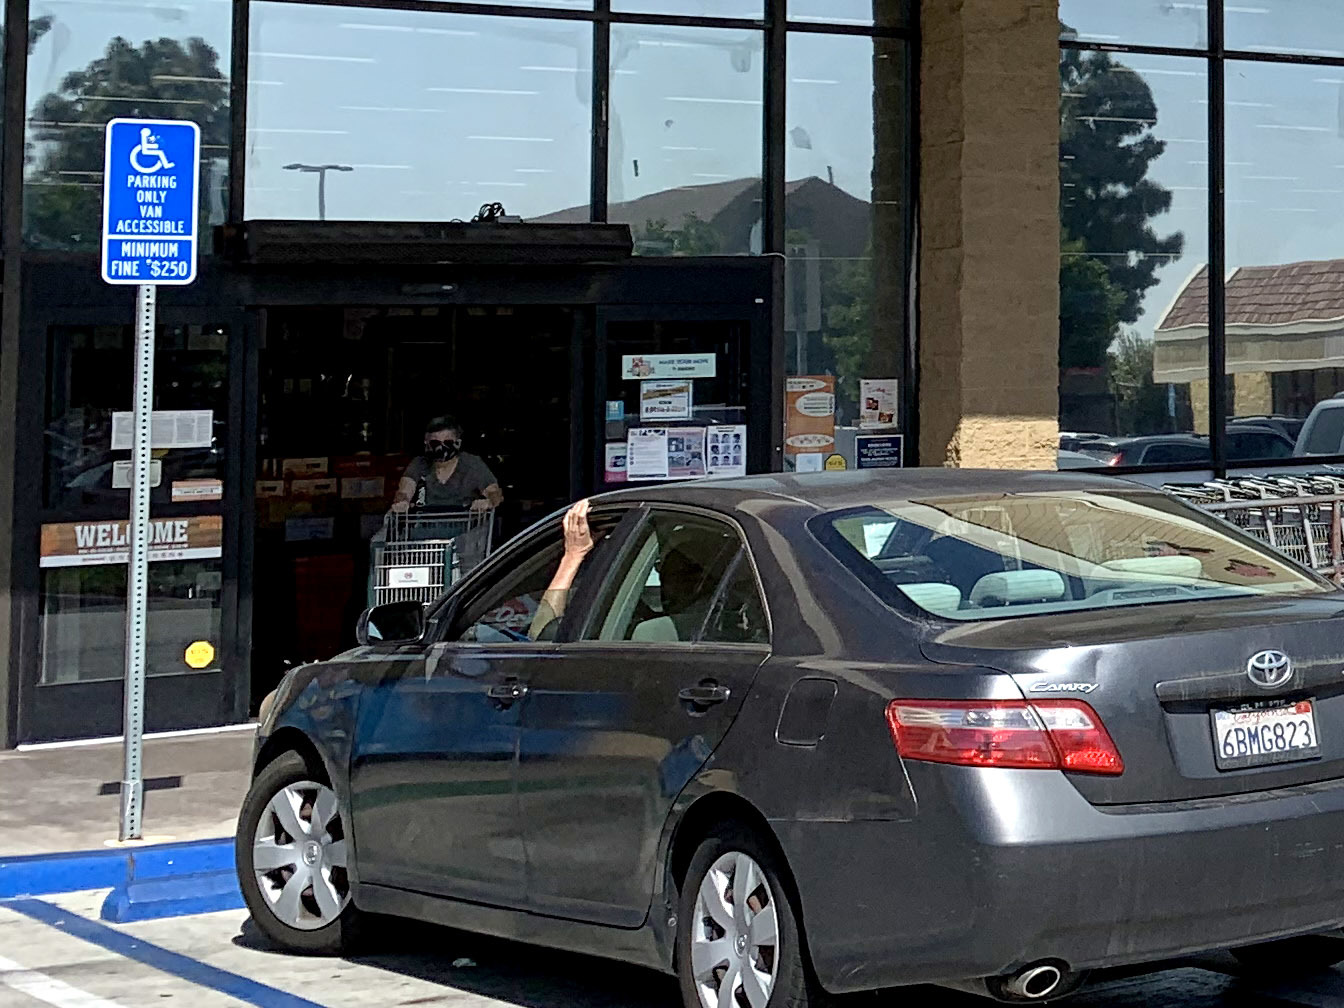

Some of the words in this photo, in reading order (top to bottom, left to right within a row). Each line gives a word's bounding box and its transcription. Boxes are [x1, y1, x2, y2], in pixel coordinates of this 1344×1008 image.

[128, 174, 177, 189] PARKING
[136, 190, 167, 203] ONLY
[139, 205, 162, 218] VAN
[116, 220, 184, 233] ACCESSIBLE
[121, 242, 178, 257] MINIMUM
[111, 260, 140, 276] FINE
[150, 260, 188, 277] $250
[1029, 682, 1100, 694] CAMRY
[1223, 720, 1312, 756] 6BMG823
